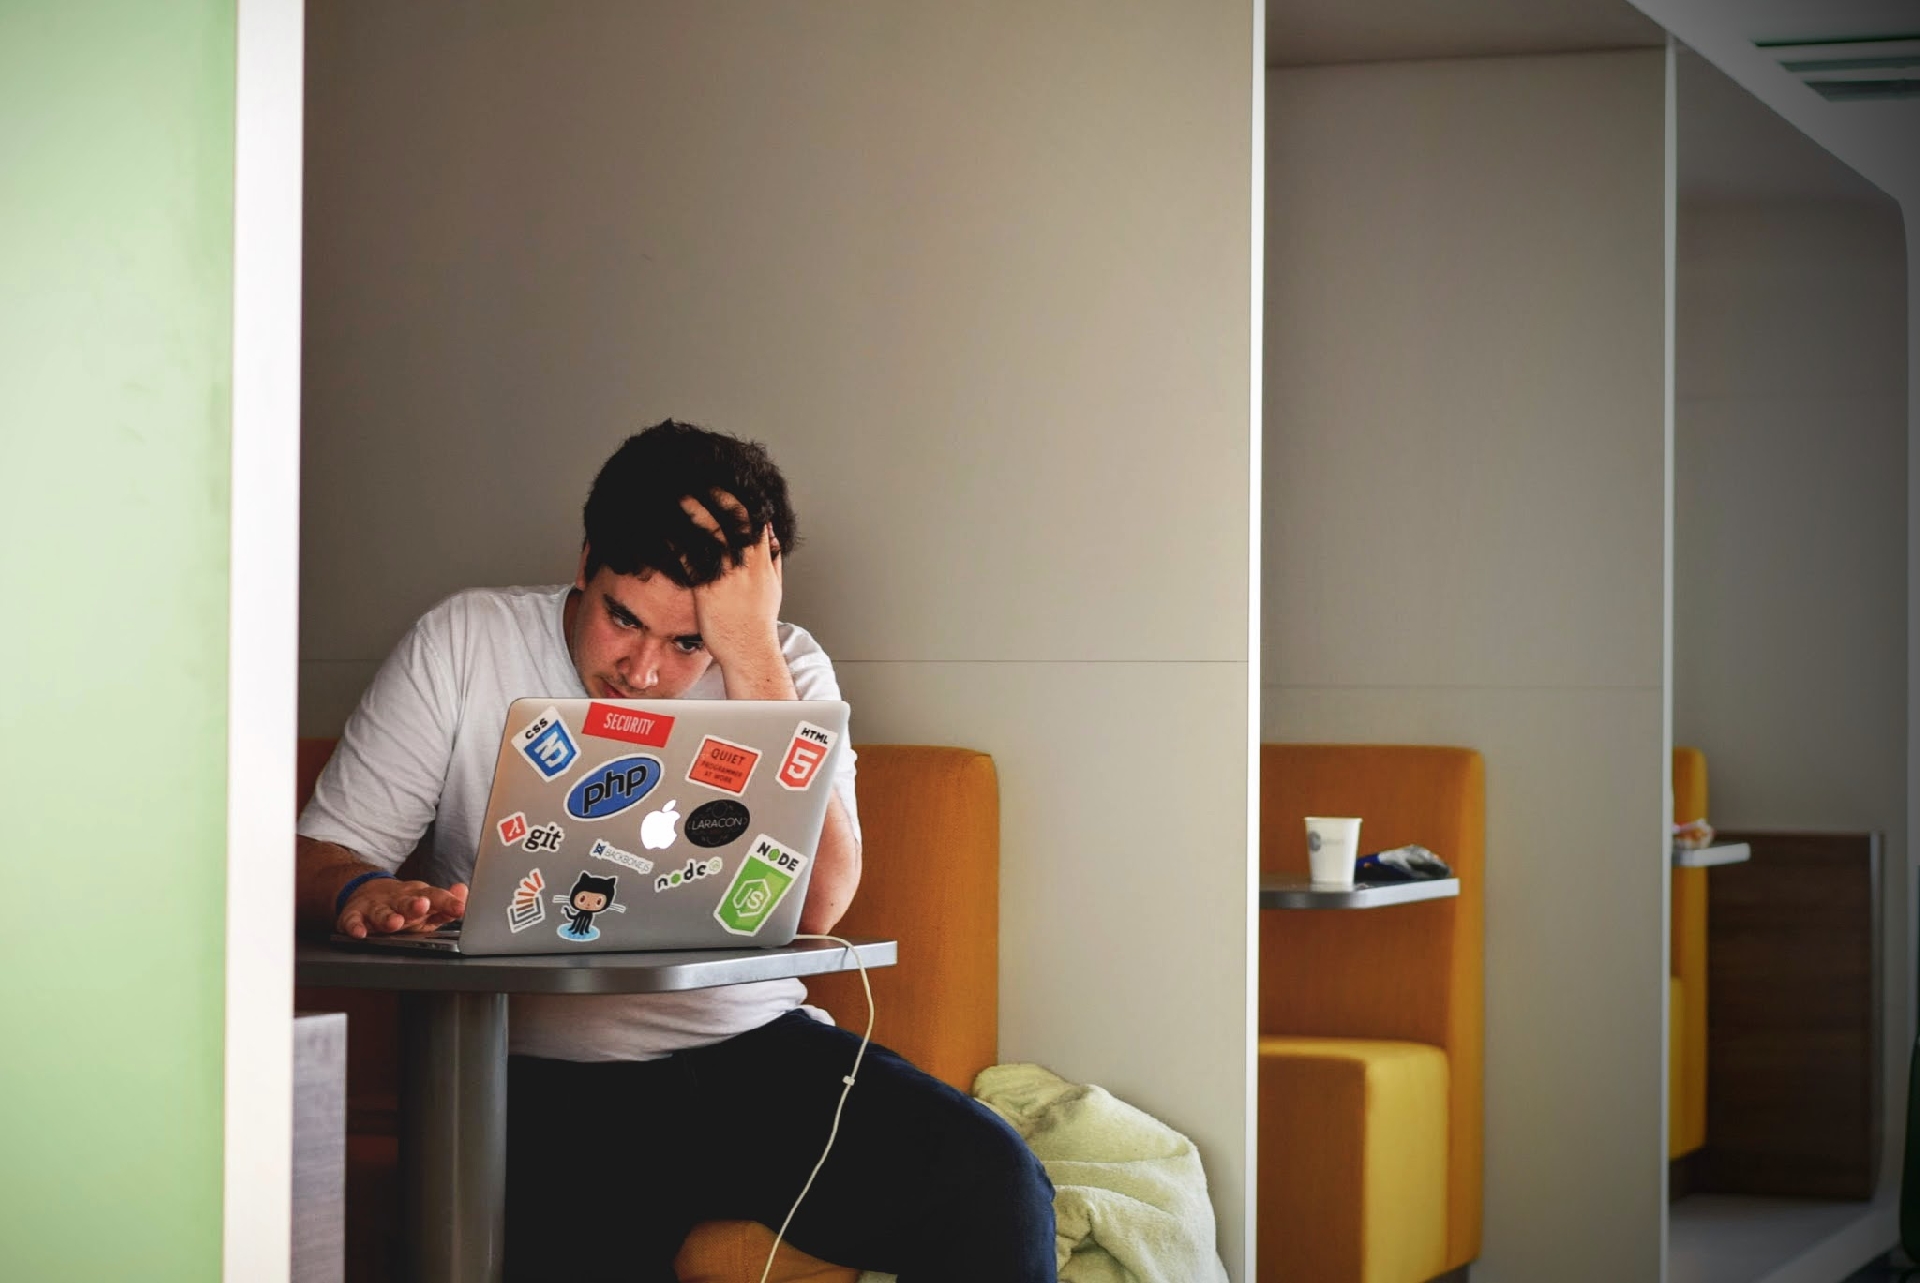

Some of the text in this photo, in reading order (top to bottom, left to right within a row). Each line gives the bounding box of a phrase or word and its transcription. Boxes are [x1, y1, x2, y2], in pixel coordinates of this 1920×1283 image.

[525, 717, 549, 740] CSS
[603, 712, 655, 735] SECURITY
[801, 727, 828, 745] HTML
[711, 748, 745, 766] QUIET
[786, 746, 818, 779] 5
[582, 763, 648, 816] php
[691, 817, 743, 830] LARACON
[524, 825, 562, 850] git
[756, 841, 799, 872] NODE
